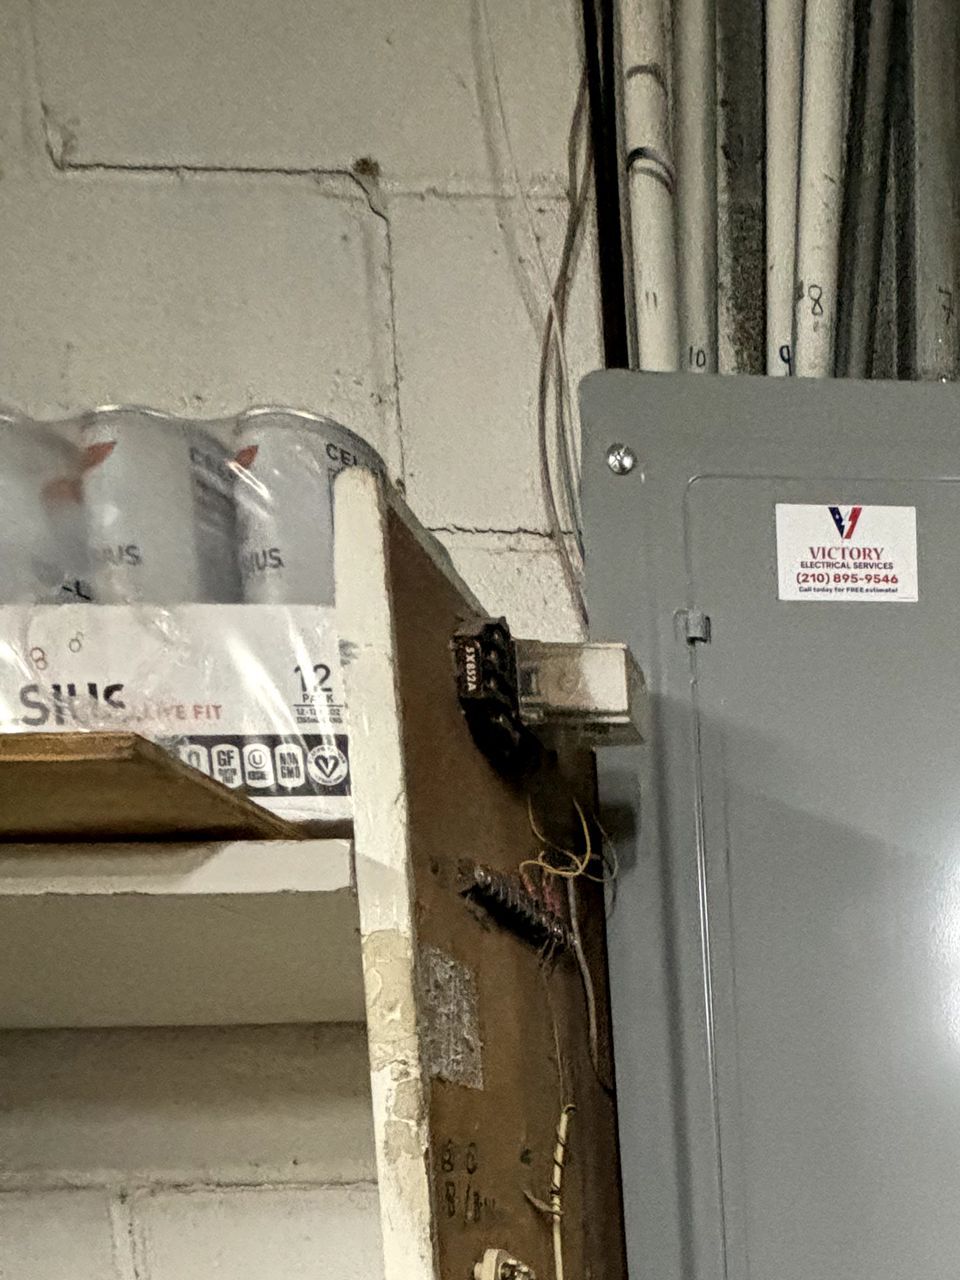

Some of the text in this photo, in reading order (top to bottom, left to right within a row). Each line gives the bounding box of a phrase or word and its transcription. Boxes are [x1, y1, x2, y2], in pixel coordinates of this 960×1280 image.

[807, 283, 824, 316] 8
[688, 345, 706, 368] 10
[779, 344, 793, 377] 9
[808, 546, 885, 561] VICTORY
[800, 561, 894, 570] ELECTRICAL SERVICES
[796, 572, 899, 585] (210) 895-9546
[813, 586, 833, 594] today
[846, 586, 864, 594] FREE
[193, 703, 223, 721] FIT
[216, 750, 235, 767] GF
